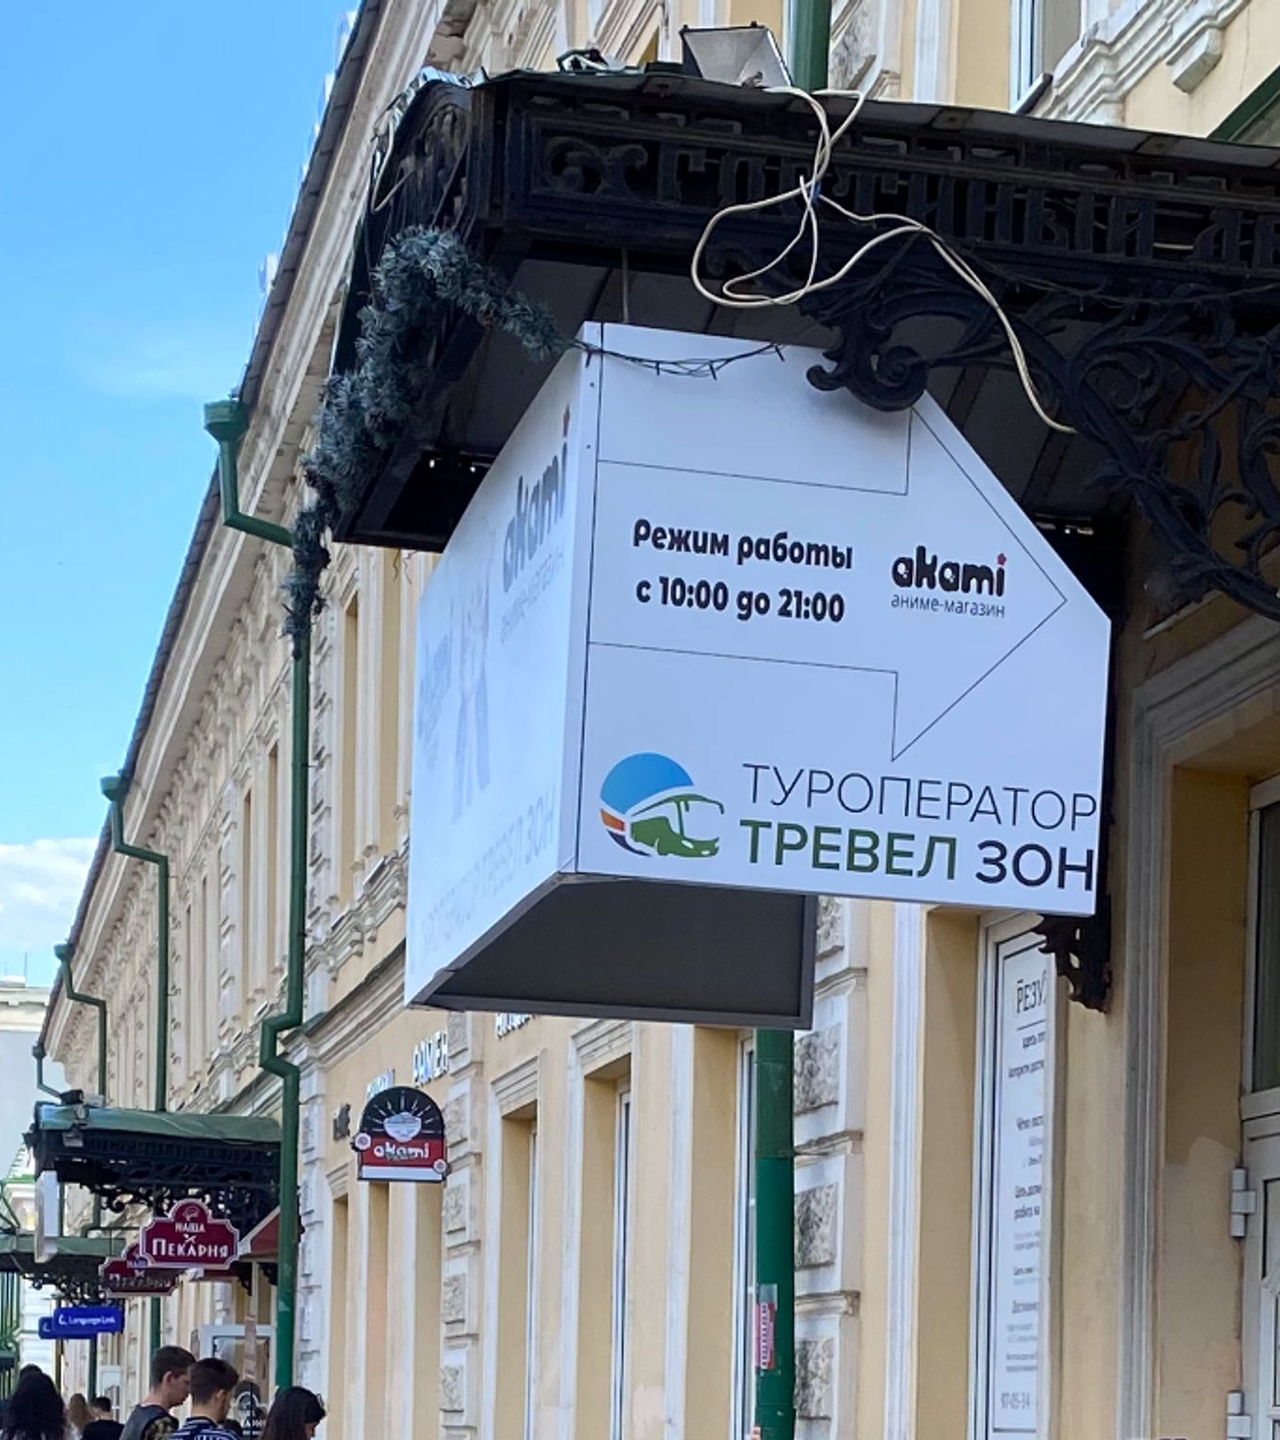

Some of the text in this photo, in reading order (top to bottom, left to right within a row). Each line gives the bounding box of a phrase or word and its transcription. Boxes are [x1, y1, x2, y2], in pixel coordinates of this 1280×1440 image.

[503, 403, 571, 594] akami
[633, 518, 853, 570] Режим работы
[891, 545, 1007, 595] akami
[636, 580, 652, 603] с
[658, 575, 729, 612] 10:00
[777, 588, 845, 624] 21:00
[890, 594, 1006, 619] аниме-магазин
[742, 763, 1097, 832] ТУРОПЕРАТОР
[739, 818, 1095, 893] ТРЕВЕЛ ЗОН
[373, 1141, 430, 1159] akami
[175, 1222, 206, 1233] НАША
